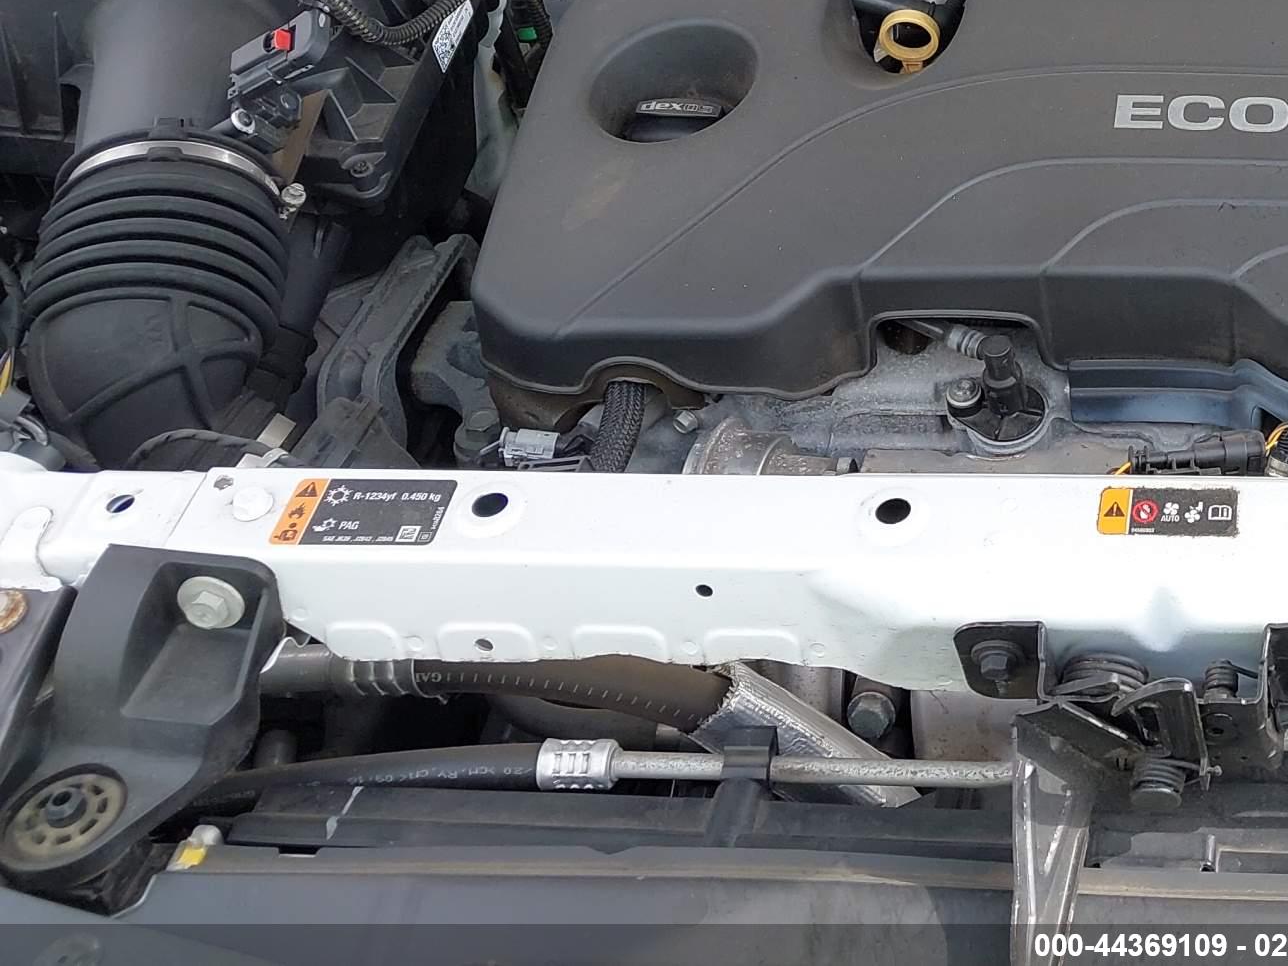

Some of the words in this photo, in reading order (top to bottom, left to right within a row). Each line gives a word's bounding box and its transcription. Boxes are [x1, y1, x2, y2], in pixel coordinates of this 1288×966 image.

[352, 492, 397, 502] R-1234yf
[401, 492, 428, 501] 0.450
[428, 492, 442, 502] kg
[338, 520, 360, 530] PAG
